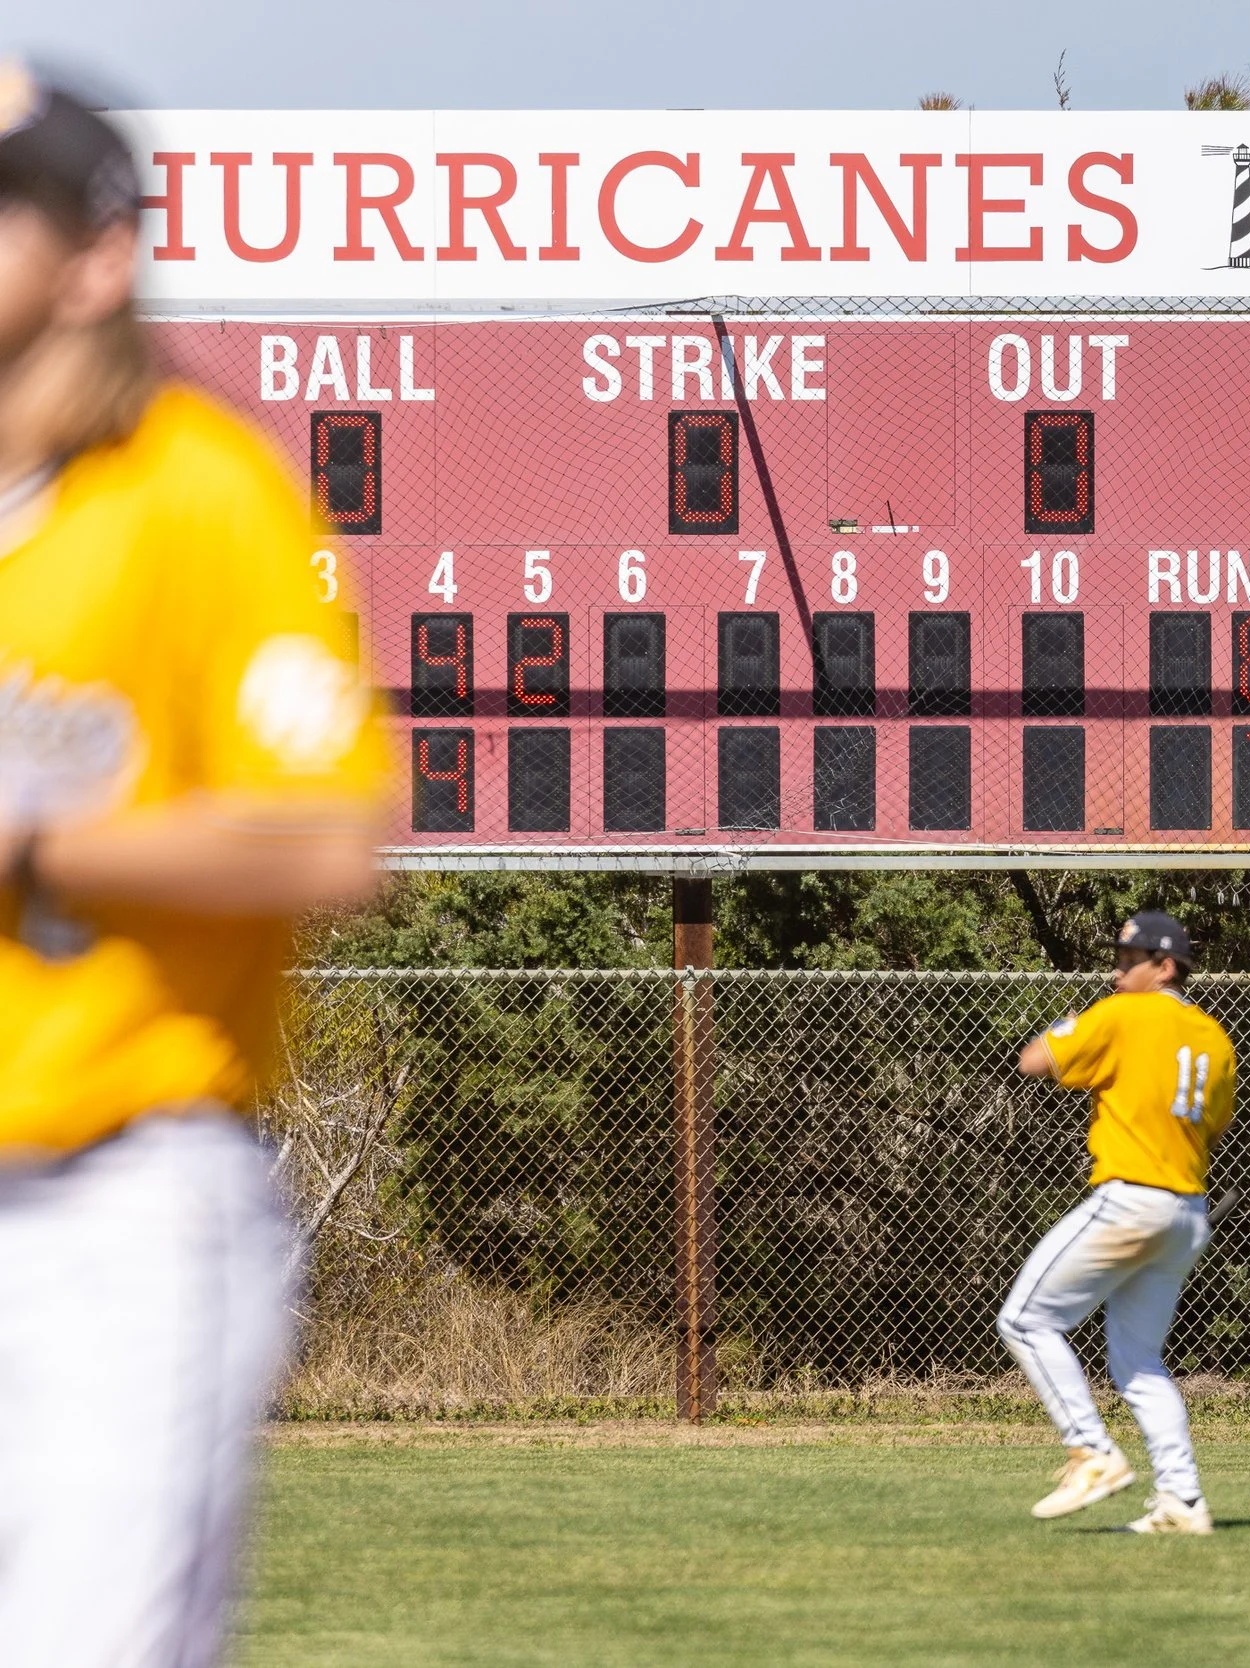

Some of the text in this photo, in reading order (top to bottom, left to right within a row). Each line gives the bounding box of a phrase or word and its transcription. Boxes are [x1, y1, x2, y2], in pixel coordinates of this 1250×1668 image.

[260, 334, 436, 402] BALL
[582, 333, 827, 402] STRIKE
[988, 333, 1129, 402] OUT
[317, 415, 375, 523] 0
[674, 415, 732, 523] 0
[1030, 415, 1088, 522] 0
[309, 550, 339, 604] 3
[428, 551, 458, 604] 4
[523, 550, 553, 604] 5
[618, 549, 647, 603] 6
[738, 550, 767, 604] 7
[830, 550, 858, 604] 8
[922, 549, 950, 604] 9
[1019, 549, 1080, 604] 10
[418, 624, 466, 698] 4
[514, 618, 562, 704] 2
[419, 739, 468, 814] 4
[1170, 1045, 1210, 1124] 11
